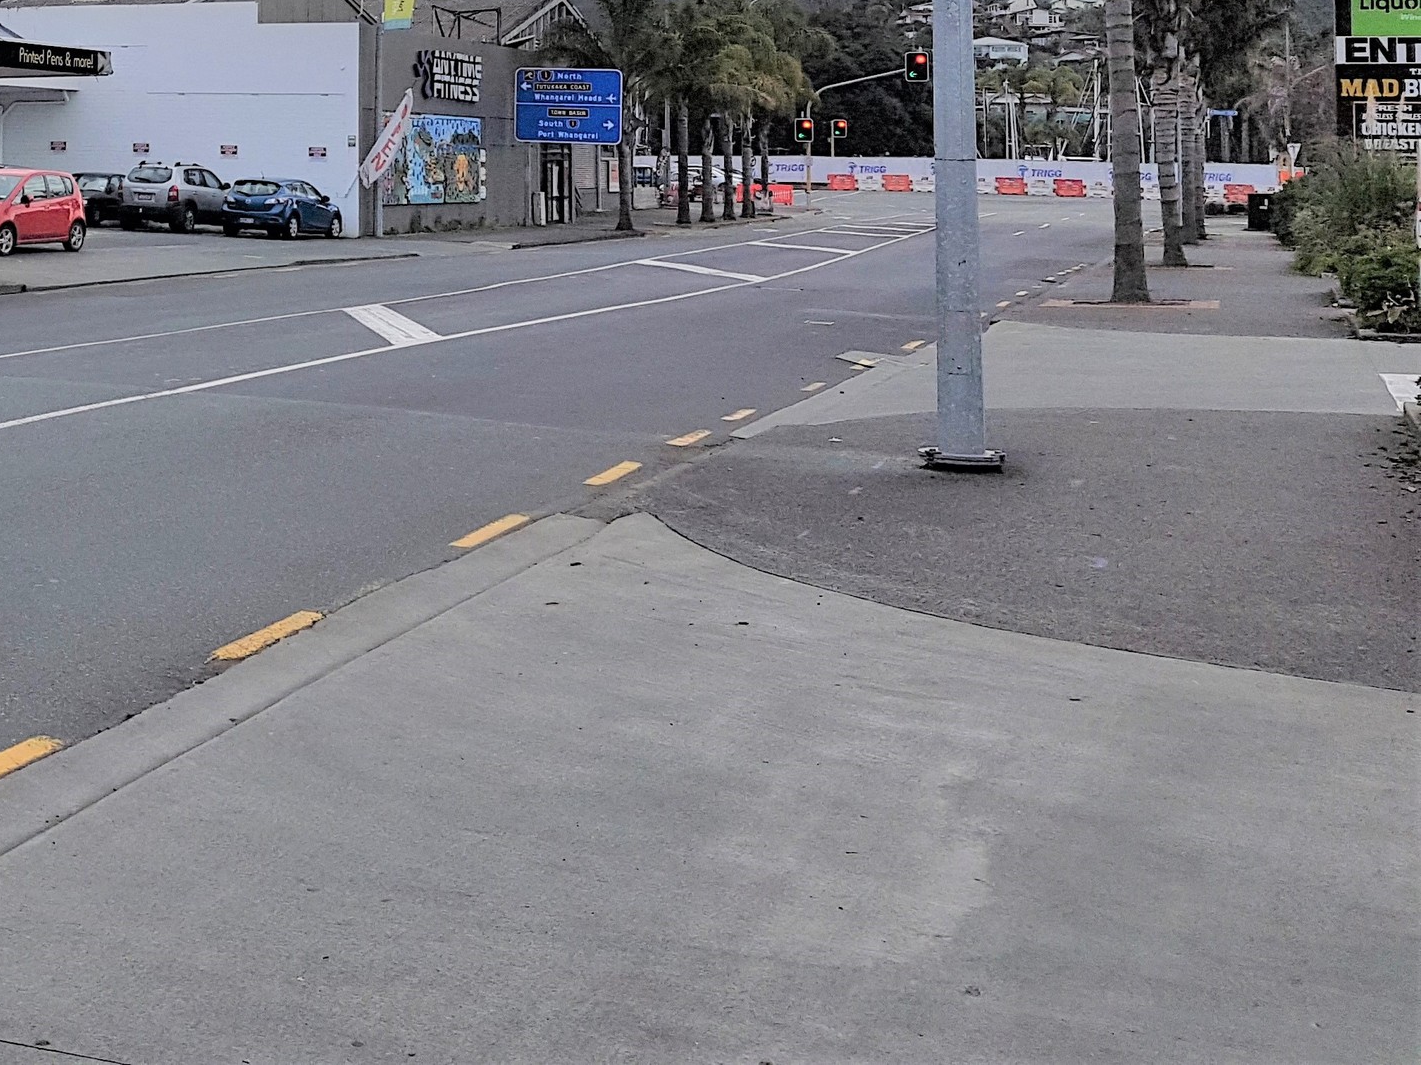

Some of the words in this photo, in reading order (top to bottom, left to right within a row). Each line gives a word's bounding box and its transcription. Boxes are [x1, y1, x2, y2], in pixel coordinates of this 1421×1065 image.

[18, 46, 45, 64] Printed
[46, 49, 63, 66] Pens
[65, 51, 72, 67] &
[73, 53, 94, 69] more!
[433, 49, 482, 79] ANYTIME
[557, 72, 582, 81] North
[433, 74, 480, 102] FITNESS
[1340, 78, 1399, 97] MAD
[1403, 78, 1421, 98] B
[534, 93, 575, 103] Whangarei
[578, 94, 602, 102] Heads
[538, 119, 564, 127] South
[538, 130, 554, 138] Port
[558, 131, 598, 140] Whangarei
[775, 163, 805, 172] TRIGG
[859, 165, 887, 173] TRIGG
[1031, 168, 1062, 178] TRIGG
